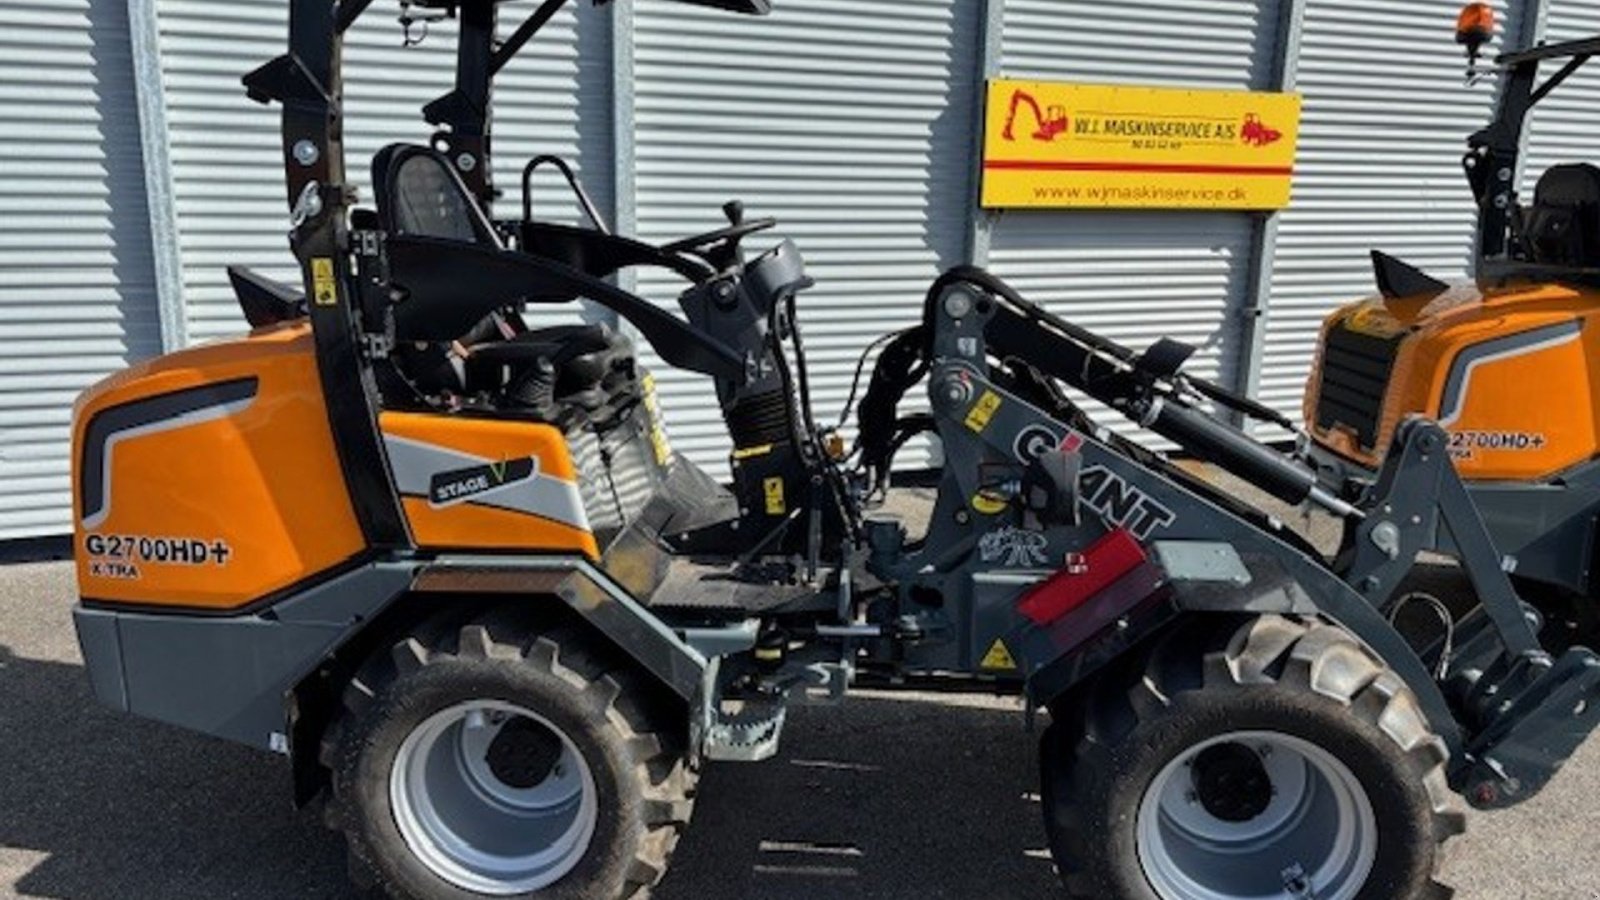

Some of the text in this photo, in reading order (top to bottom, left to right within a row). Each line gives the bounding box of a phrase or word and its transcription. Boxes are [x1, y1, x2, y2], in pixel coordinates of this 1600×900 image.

[1104, 119, 1210, 138] MASKINSERVICE
[1033, 184, 1247, 202] www.wjmaskinservice.dk
[1446, 432, 1543, 449] 2700HD+
[436, 474, 489, 499] STAGE
[86, 534, 229, 564] G2700HD+
